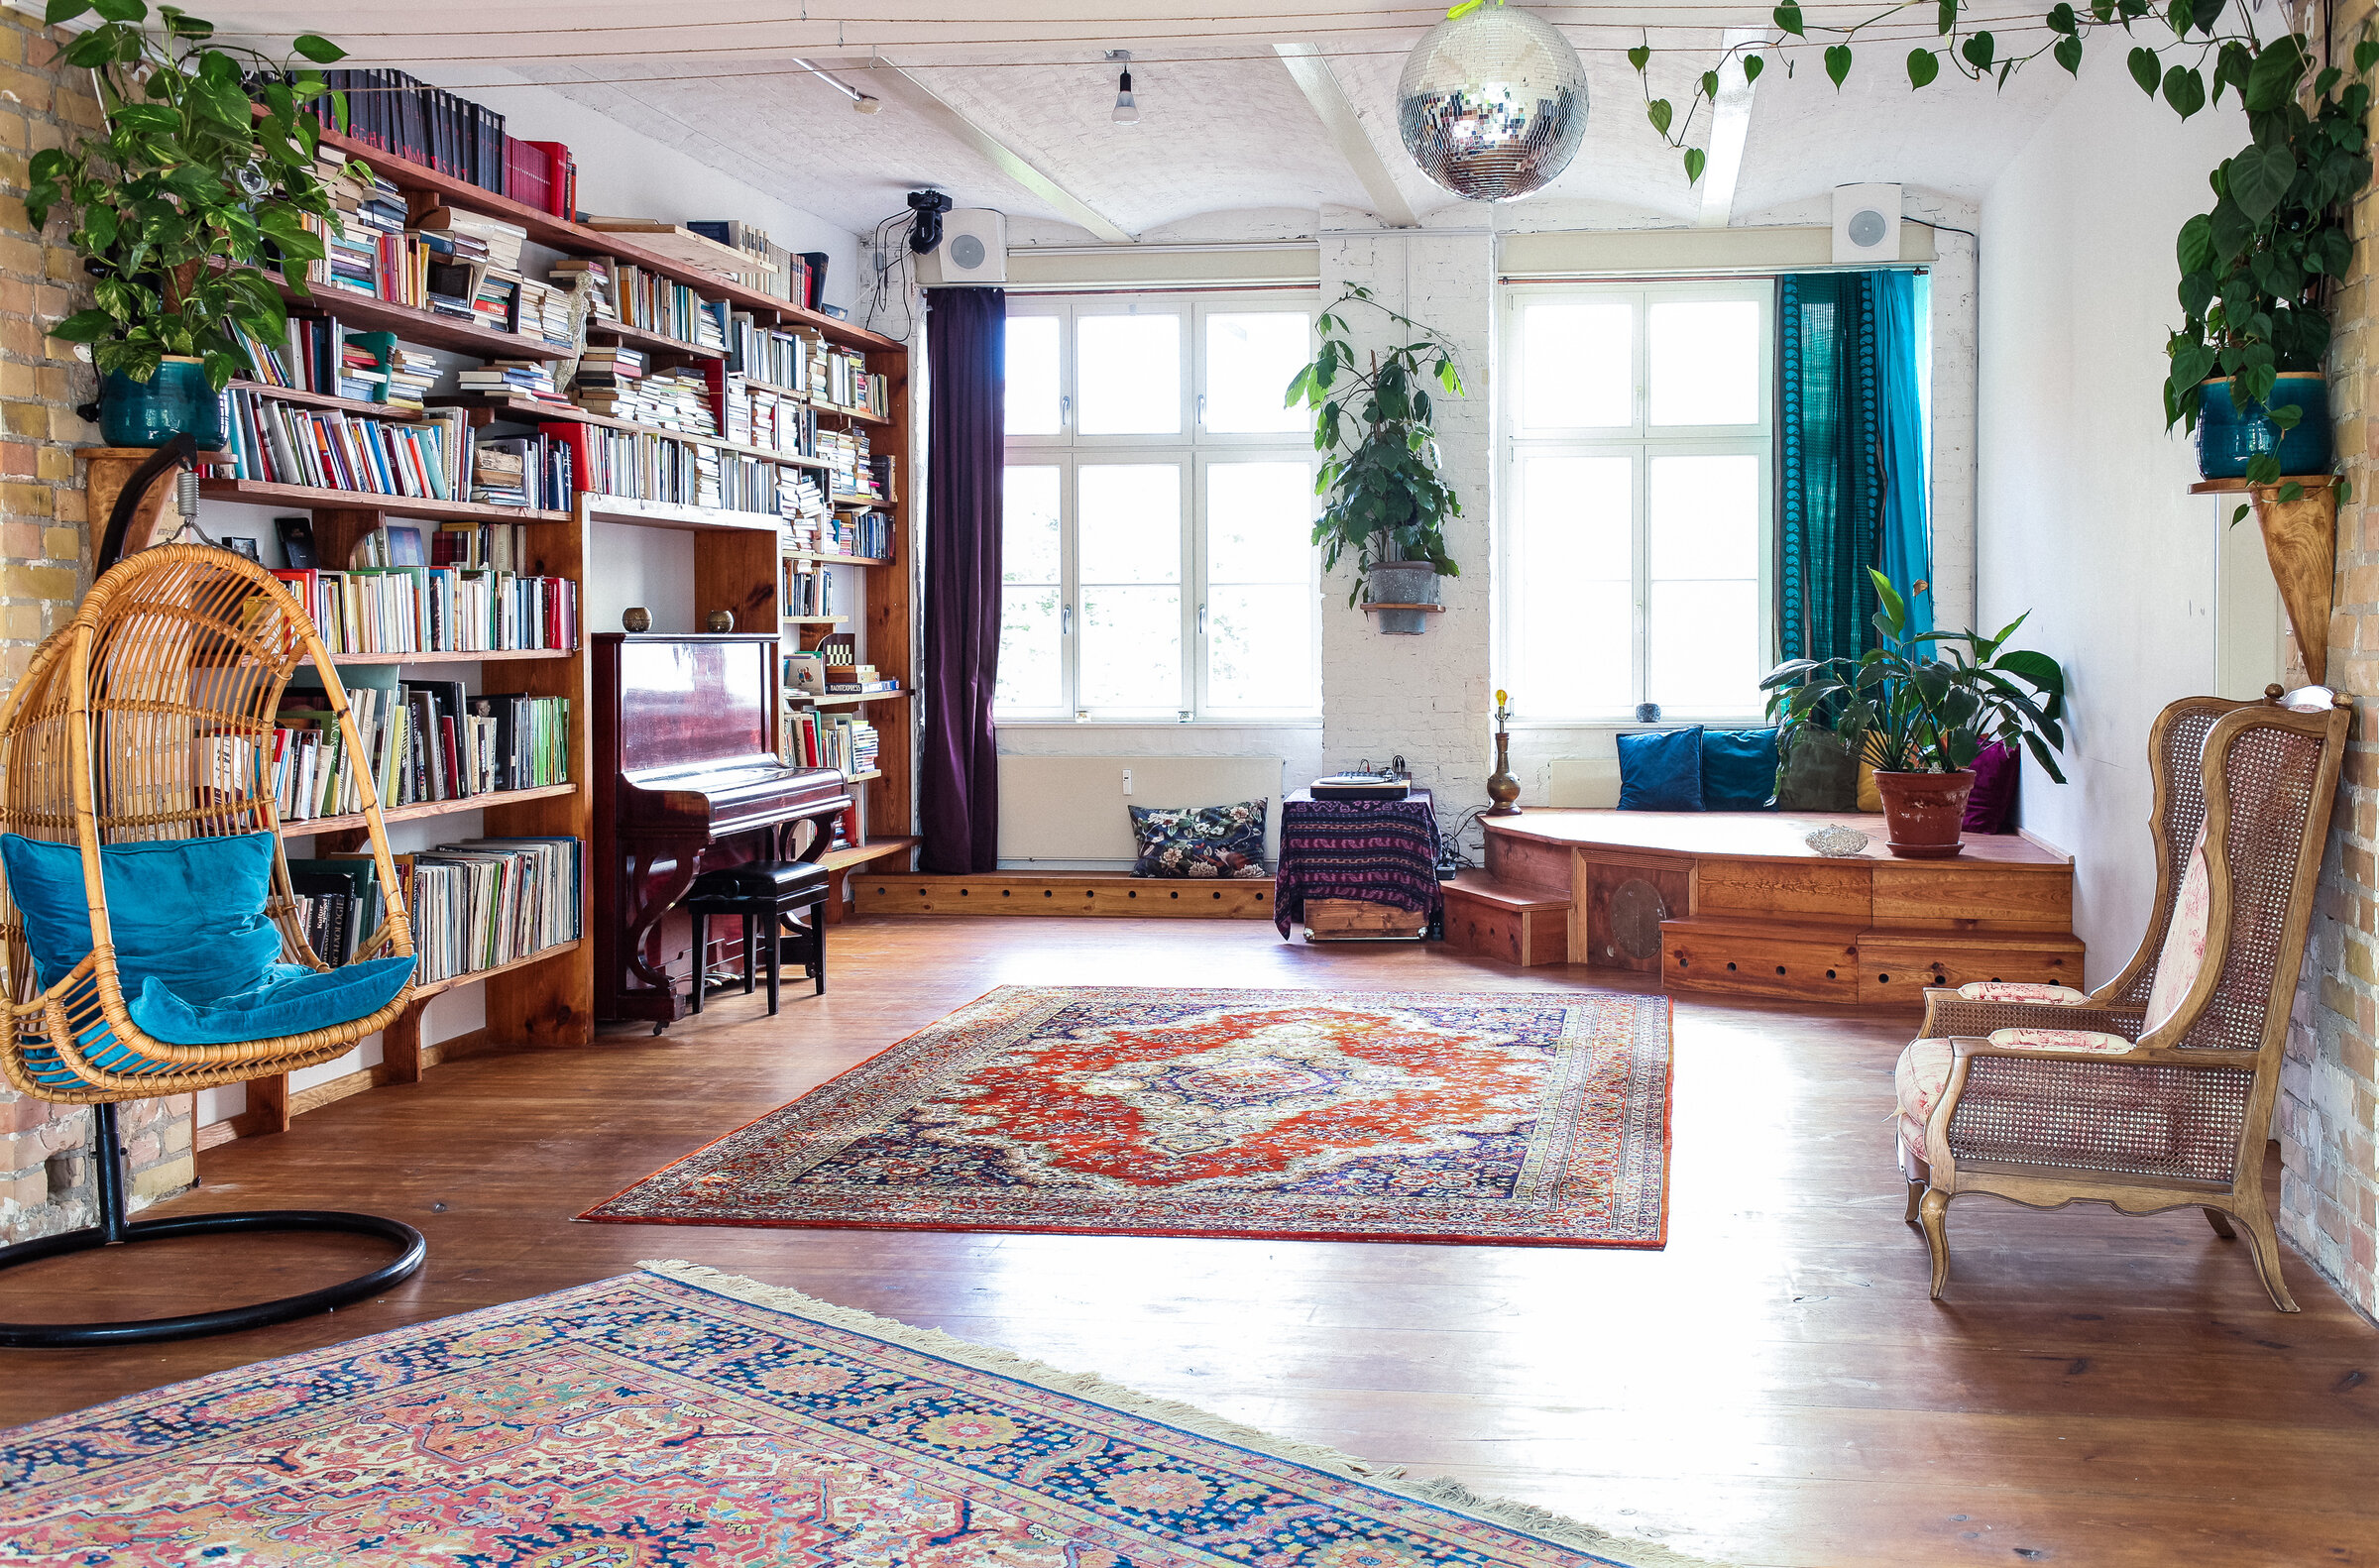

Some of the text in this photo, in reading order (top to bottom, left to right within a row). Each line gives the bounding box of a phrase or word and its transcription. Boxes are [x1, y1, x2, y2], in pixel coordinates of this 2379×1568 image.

[349, 124, 359, 139] G
[369, 131, 378, 147] H
[380, 135, 388, 151] K
